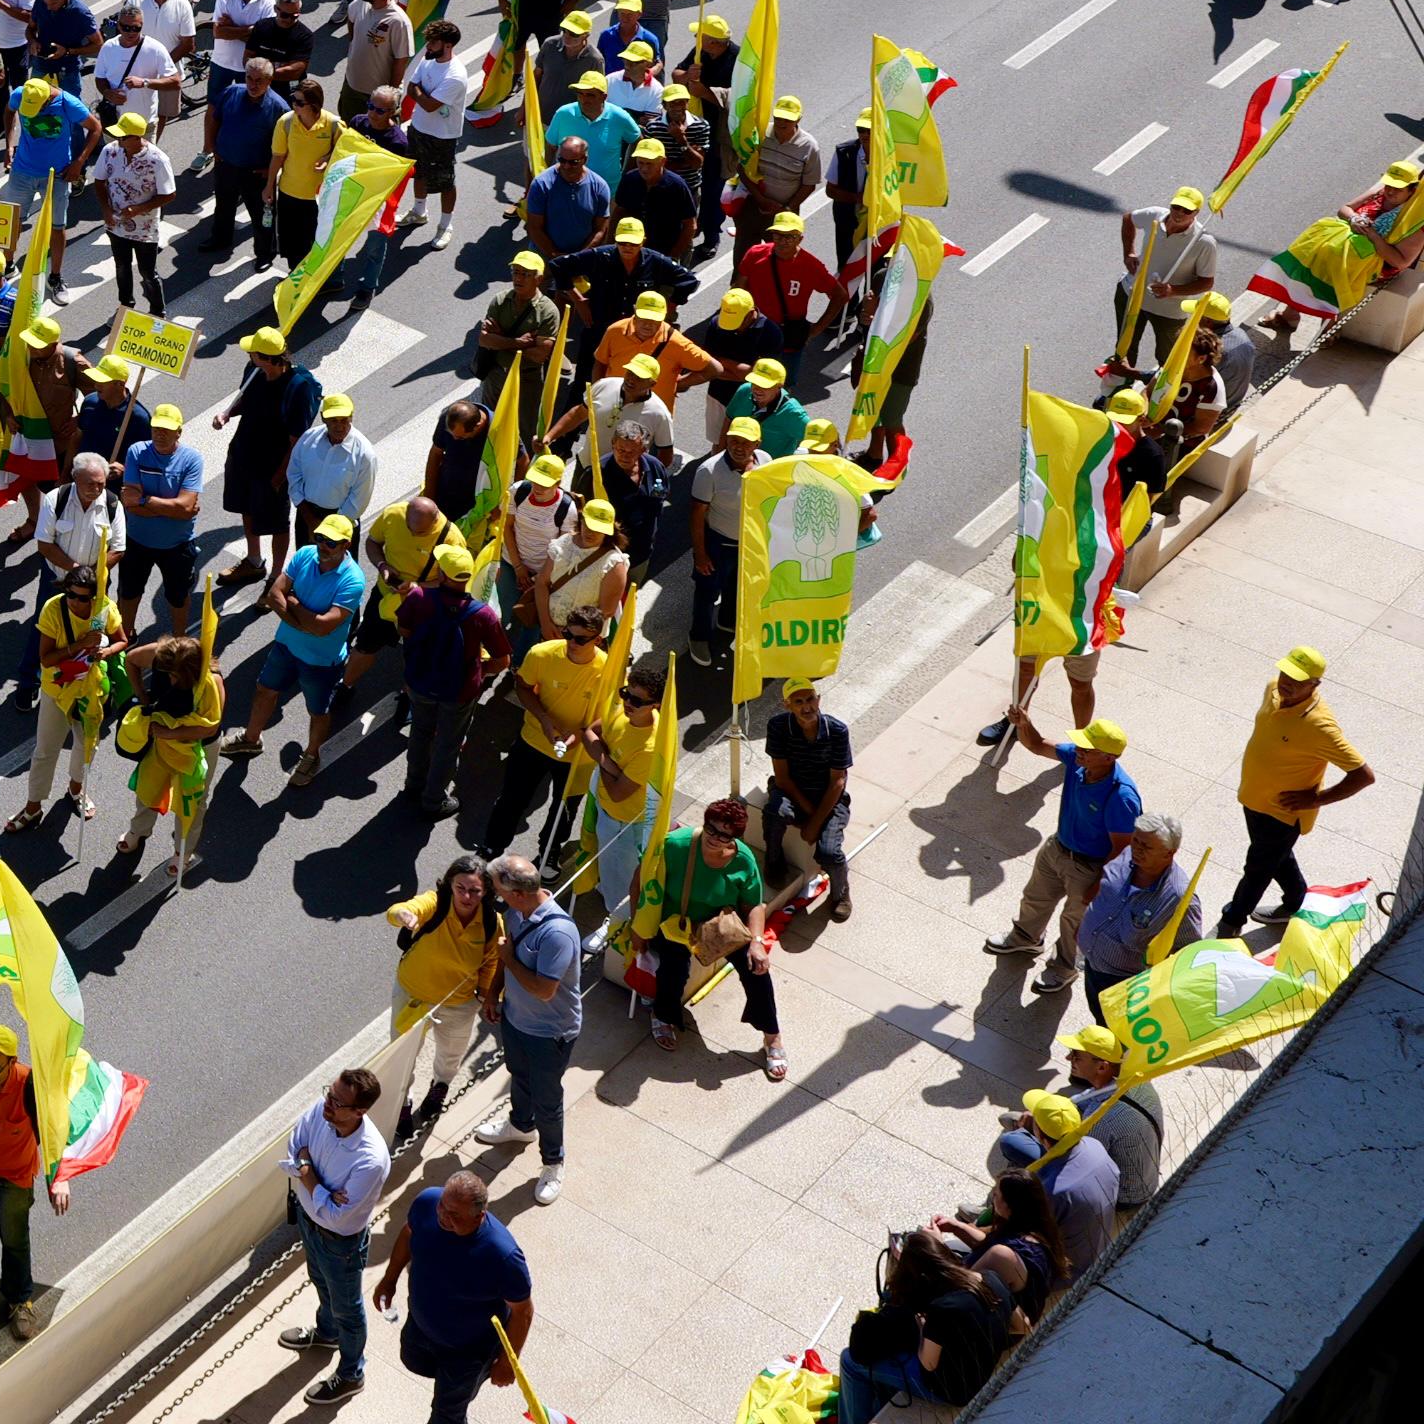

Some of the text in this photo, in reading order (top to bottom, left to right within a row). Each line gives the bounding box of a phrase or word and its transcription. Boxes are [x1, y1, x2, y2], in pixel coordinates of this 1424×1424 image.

[122, 326, 185, 353] STOP GRANO
[120, 339, 179, 369] GIRAMONDO
